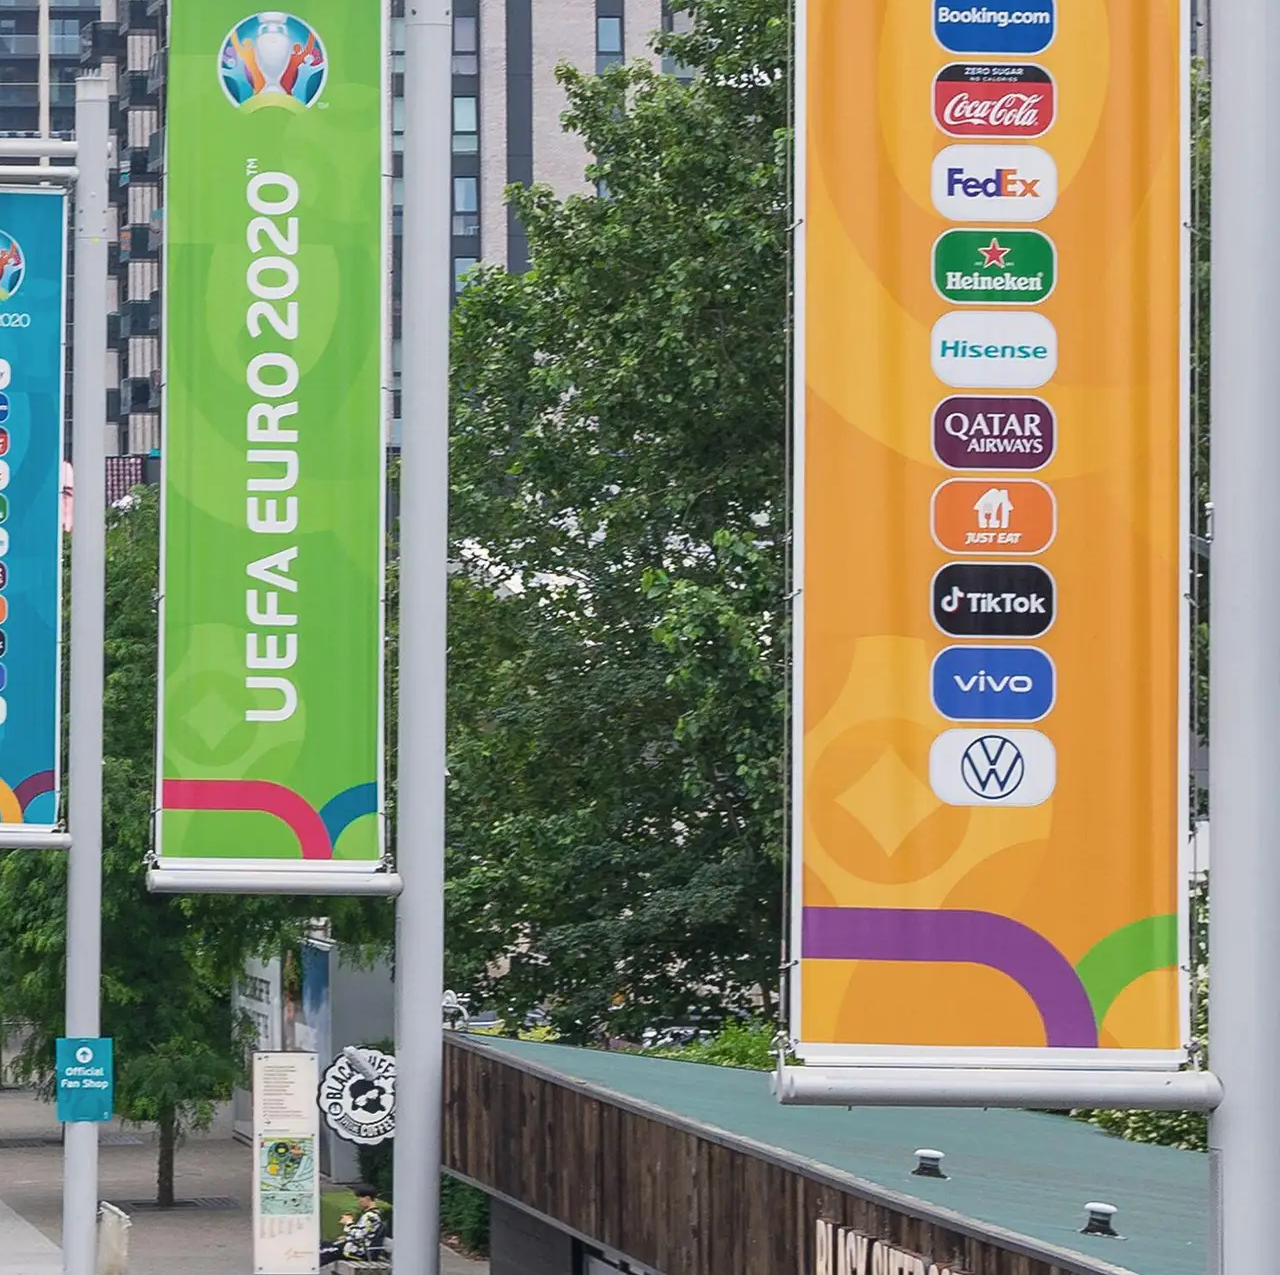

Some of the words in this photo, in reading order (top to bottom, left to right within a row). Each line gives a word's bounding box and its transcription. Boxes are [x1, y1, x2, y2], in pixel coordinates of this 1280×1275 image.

[938, 6, 1050, 27] Booking.com
[964, 67, 990, 76] ZERO
[992, 67, 1024, 76] SUGAR
[947, 168, 1040, 197] FedEx
[246, 170, 301, 342] 2020
[946, 272, 1043, 291] Heineken
[940, 340, 1048, 359] Hisense
[944, 412, 1042, 440] QATAR
[247, 354, 301, 535] EURO
[967, 438, 1044, 453] AIRWAYS
[964, 532, 997, 544] JUST
[997, 532, 1022, 544] EAT
[966, 592, 1046, 613] TikTok
[246, 548, 299, 723] UEFA
[953, 670, 1033, 693] vivo
[65, 1067, 104, 1076] Official
[61, 1079, 80, 1088] Fan
[81, 1079, 109, 1090] Shop
